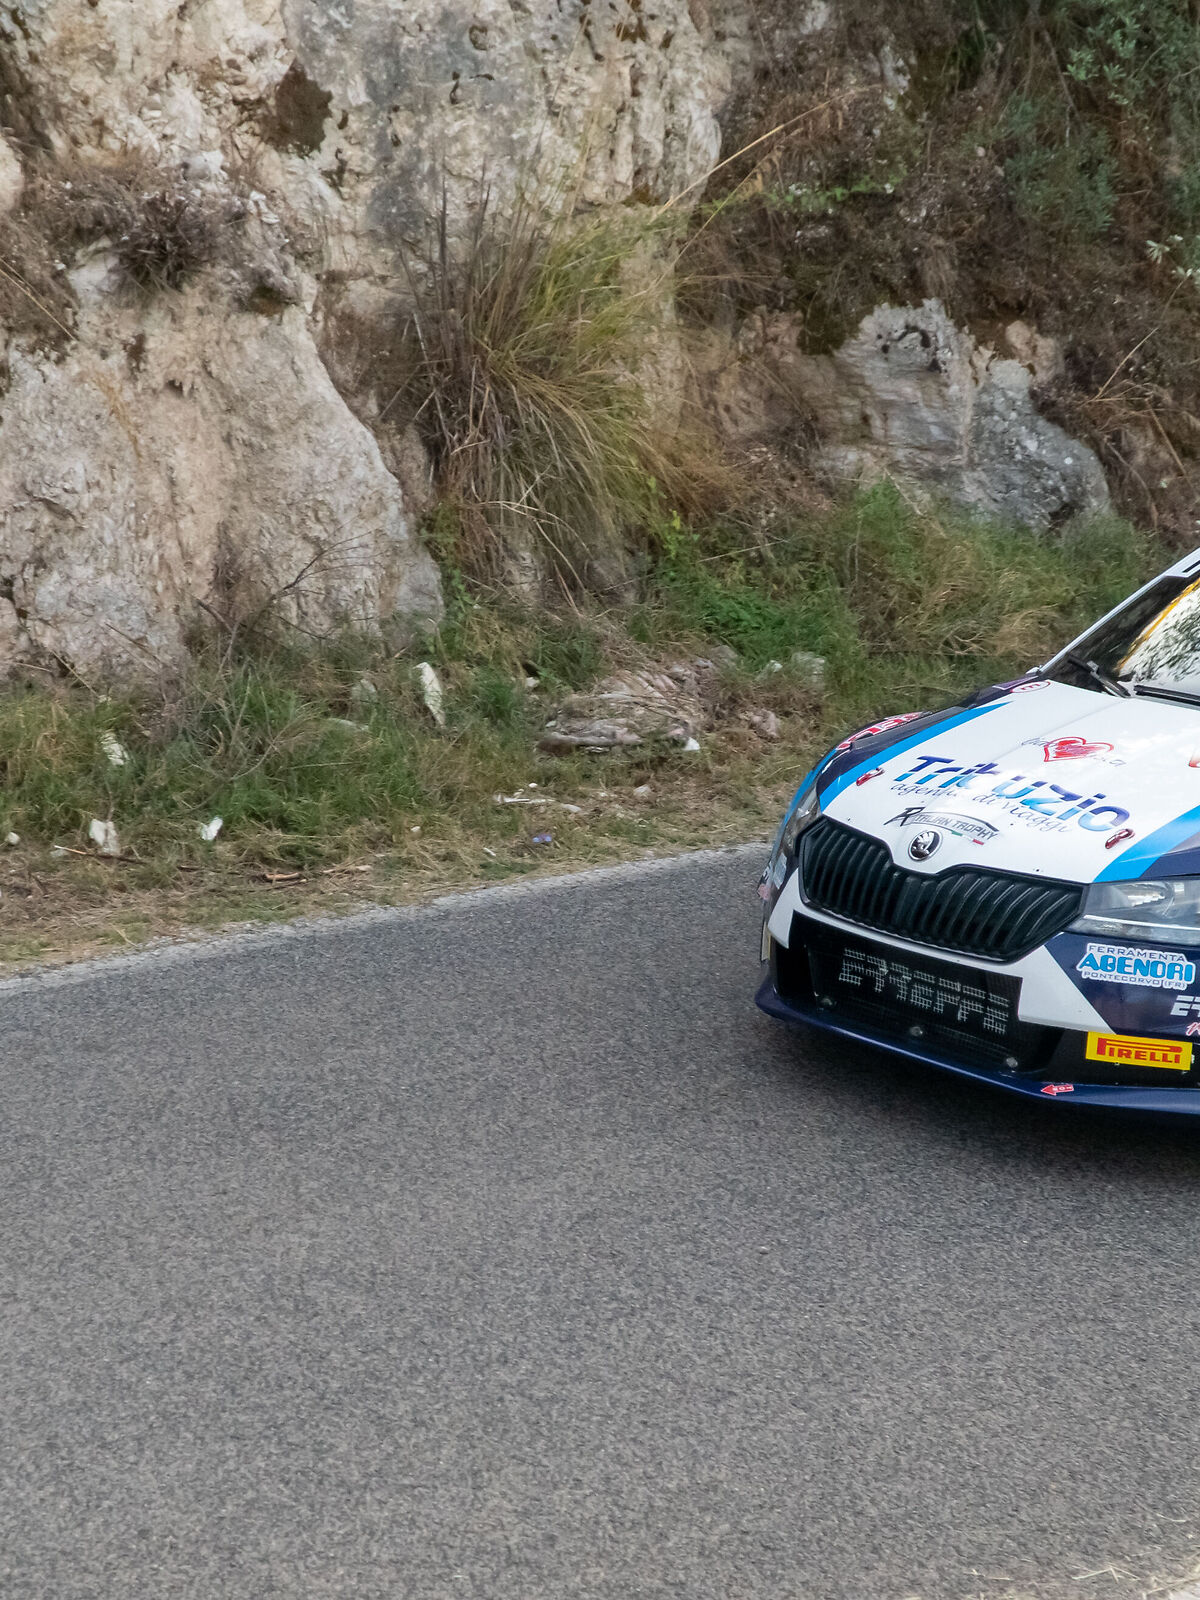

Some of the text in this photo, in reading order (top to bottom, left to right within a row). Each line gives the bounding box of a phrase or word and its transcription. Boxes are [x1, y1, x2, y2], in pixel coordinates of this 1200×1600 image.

[952, 820, 1000, 840] TROPHY
[1088, 944, 1186, 962] FERRAMENTA
[1078, 952, 1194, 982] AGENORI
[838, 947, 1010, 1035] ERREFFE
[1083, 970, 1188, 990] PONTECORVO (FR)
[1096, 1037, 1183, 1064] PIRELLI
